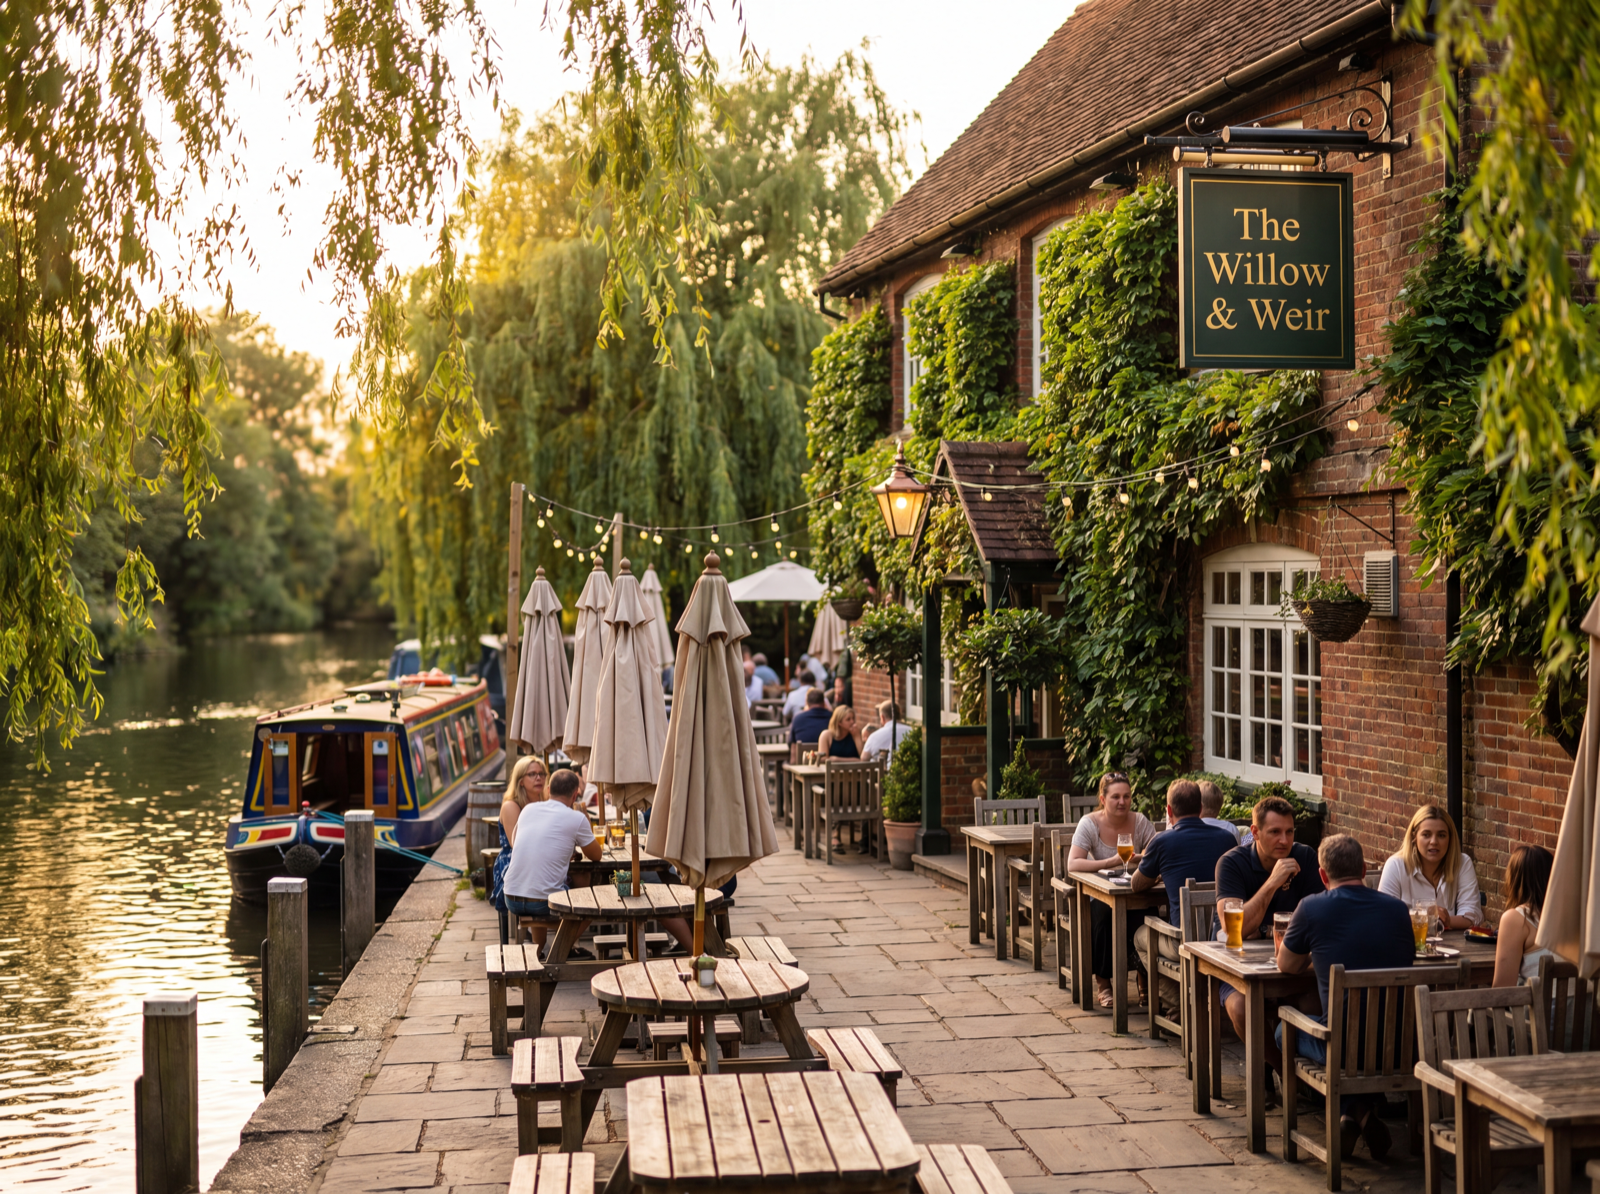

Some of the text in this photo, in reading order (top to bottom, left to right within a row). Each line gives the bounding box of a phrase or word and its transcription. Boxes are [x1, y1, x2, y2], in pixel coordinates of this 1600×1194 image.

[1233, 208, 1300, 241] The
[1203, 251, 1331, 286] Willow
[1205, 297, 1330, 331] & Weir
